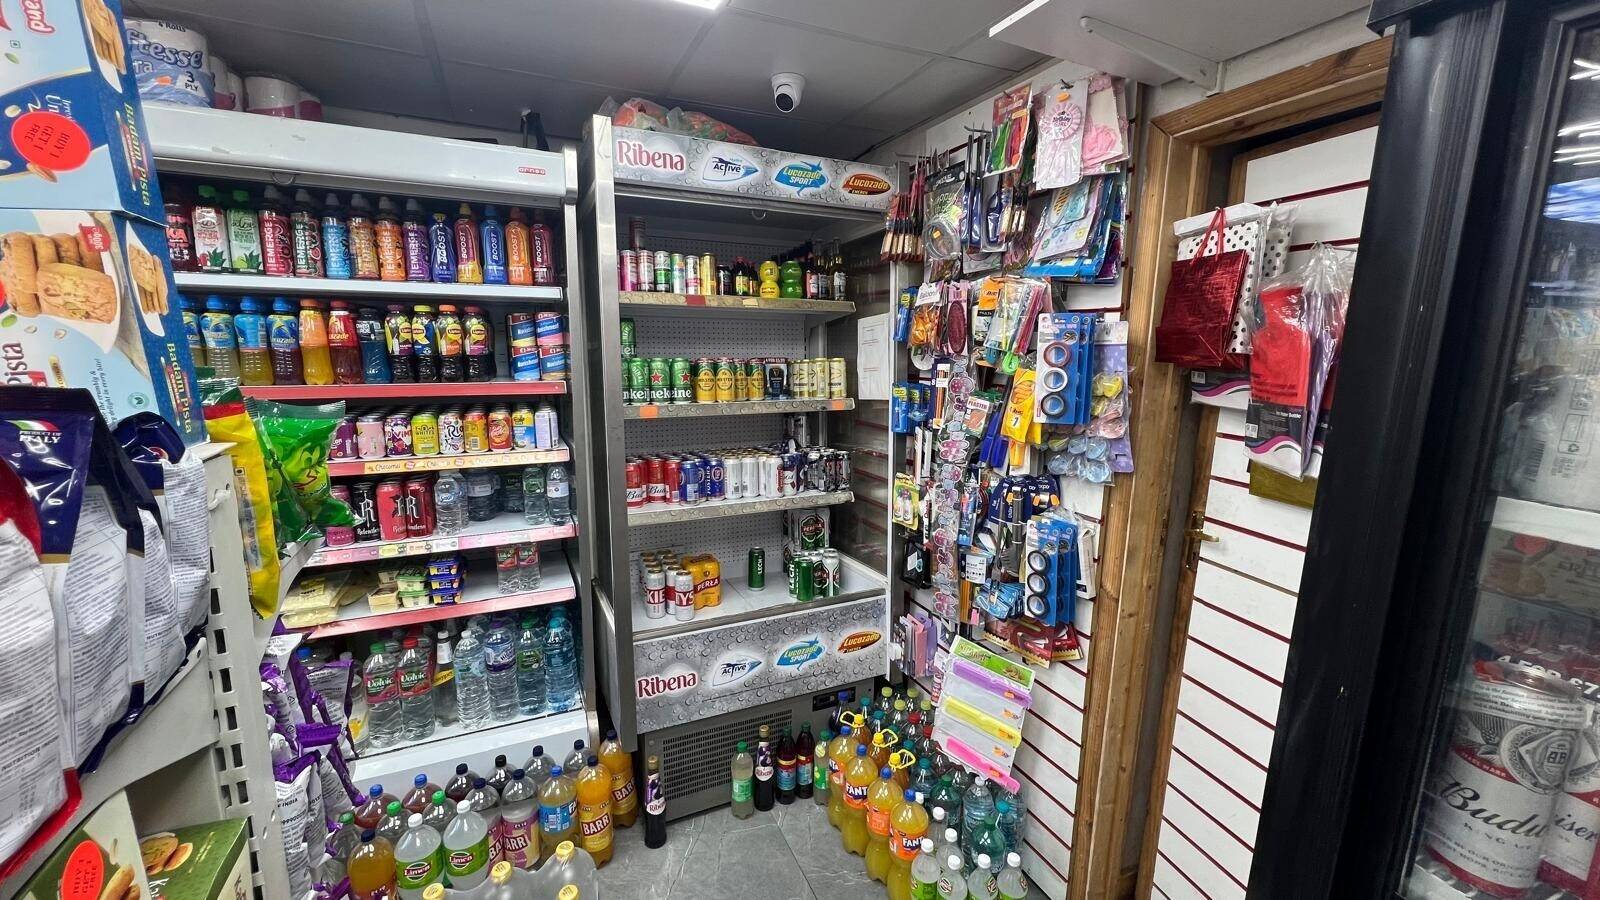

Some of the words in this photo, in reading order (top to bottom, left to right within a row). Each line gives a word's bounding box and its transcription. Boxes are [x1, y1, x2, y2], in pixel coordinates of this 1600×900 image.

[124, 102, 143, 164] Badam
[139, 166, 151, 207] Pista
[616, 140, 685, 172] Ribena
[783, 166, 822, 181] Lucozade
[789, 175, 814, 186] SPORT
[849, 176, 889, 190] Lucozade
[266, 220, 277, 268] EMERGE
[296, 222, 306, 269] EMERGE
[459, 232, 469, 260] BOOST
[492, 232, 501, 262] BOOST
[535, 237, 545, 264] BOOST
[167, 343, 186, 397] Badam
[180, 398, 193, 434] Pista
[357, 527, 379, 536] Relentle
[843, 632, 881, 646] Lucozade
[783, 644, 820, 659] Lucozade
[790, 653, 812, 664] SPORT
[366, 677, 394, 688] Volvic
[400, 671, 428, 683] Volvic
[637, 671, 697, 699] Ribena
[845, 782, 868, 796] FANT
[583, 814, 610, 836] BARR
[1555, 812, 1600, 842] iser
[489, 840, 503, 861] BA
[503, 834, 529, 852] ARR
[902, 836, 925, 851] FANT
